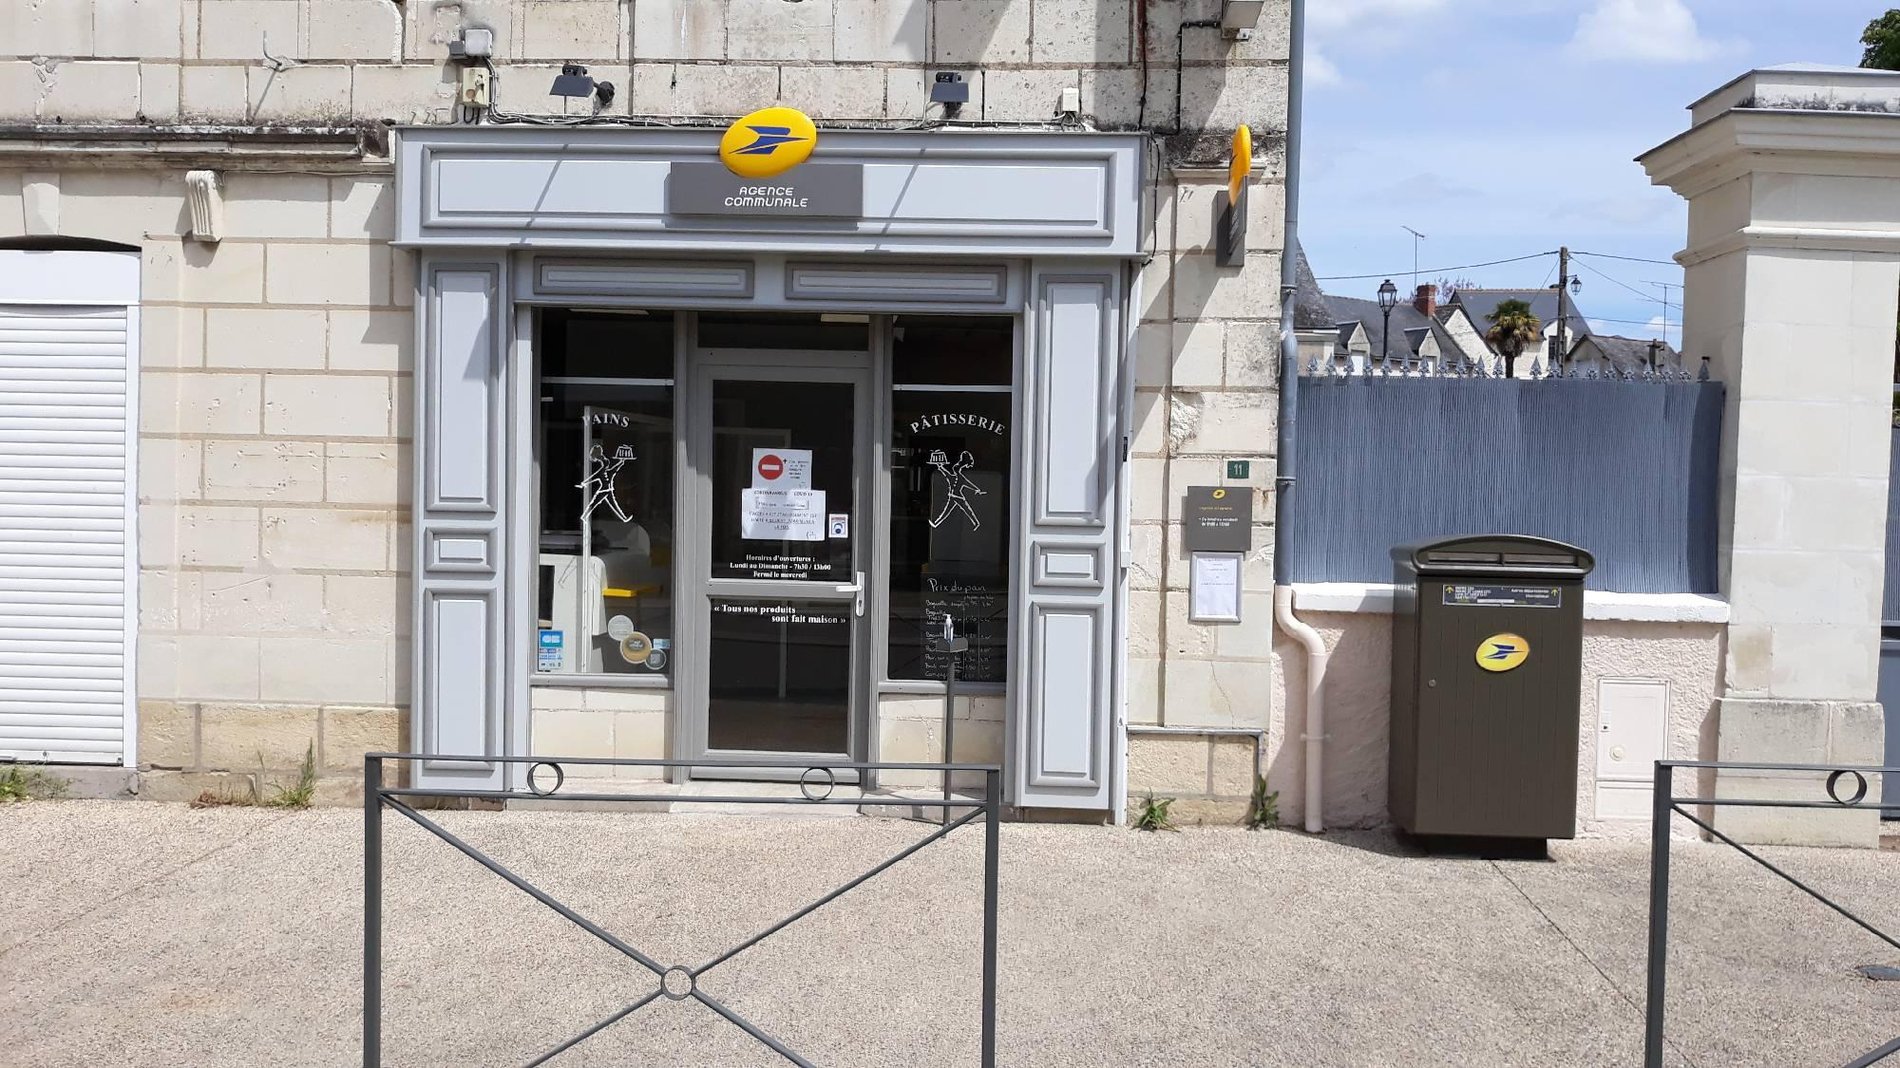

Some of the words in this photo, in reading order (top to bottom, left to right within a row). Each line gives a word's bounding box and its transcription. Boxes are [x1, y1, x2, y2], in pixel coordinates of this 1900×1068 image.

[739, 186, 794, 196] AGENCE
[724, 197, 809, 208] COMMUNALE
[910, 413, 1006, 436] PÂTISSERIE
[1233, 463, 1243, 476] 11
[746, 554, 772, 562] Horaires
[758, 562, 788, 570] Dimanche
[722, 604, 742, 613] Tous
[760, 606, 796, 615] produits
[771, 614, 789, 623] sont
[791, 614, 806, 623] fait
[808, 615, 838, 624] maison
